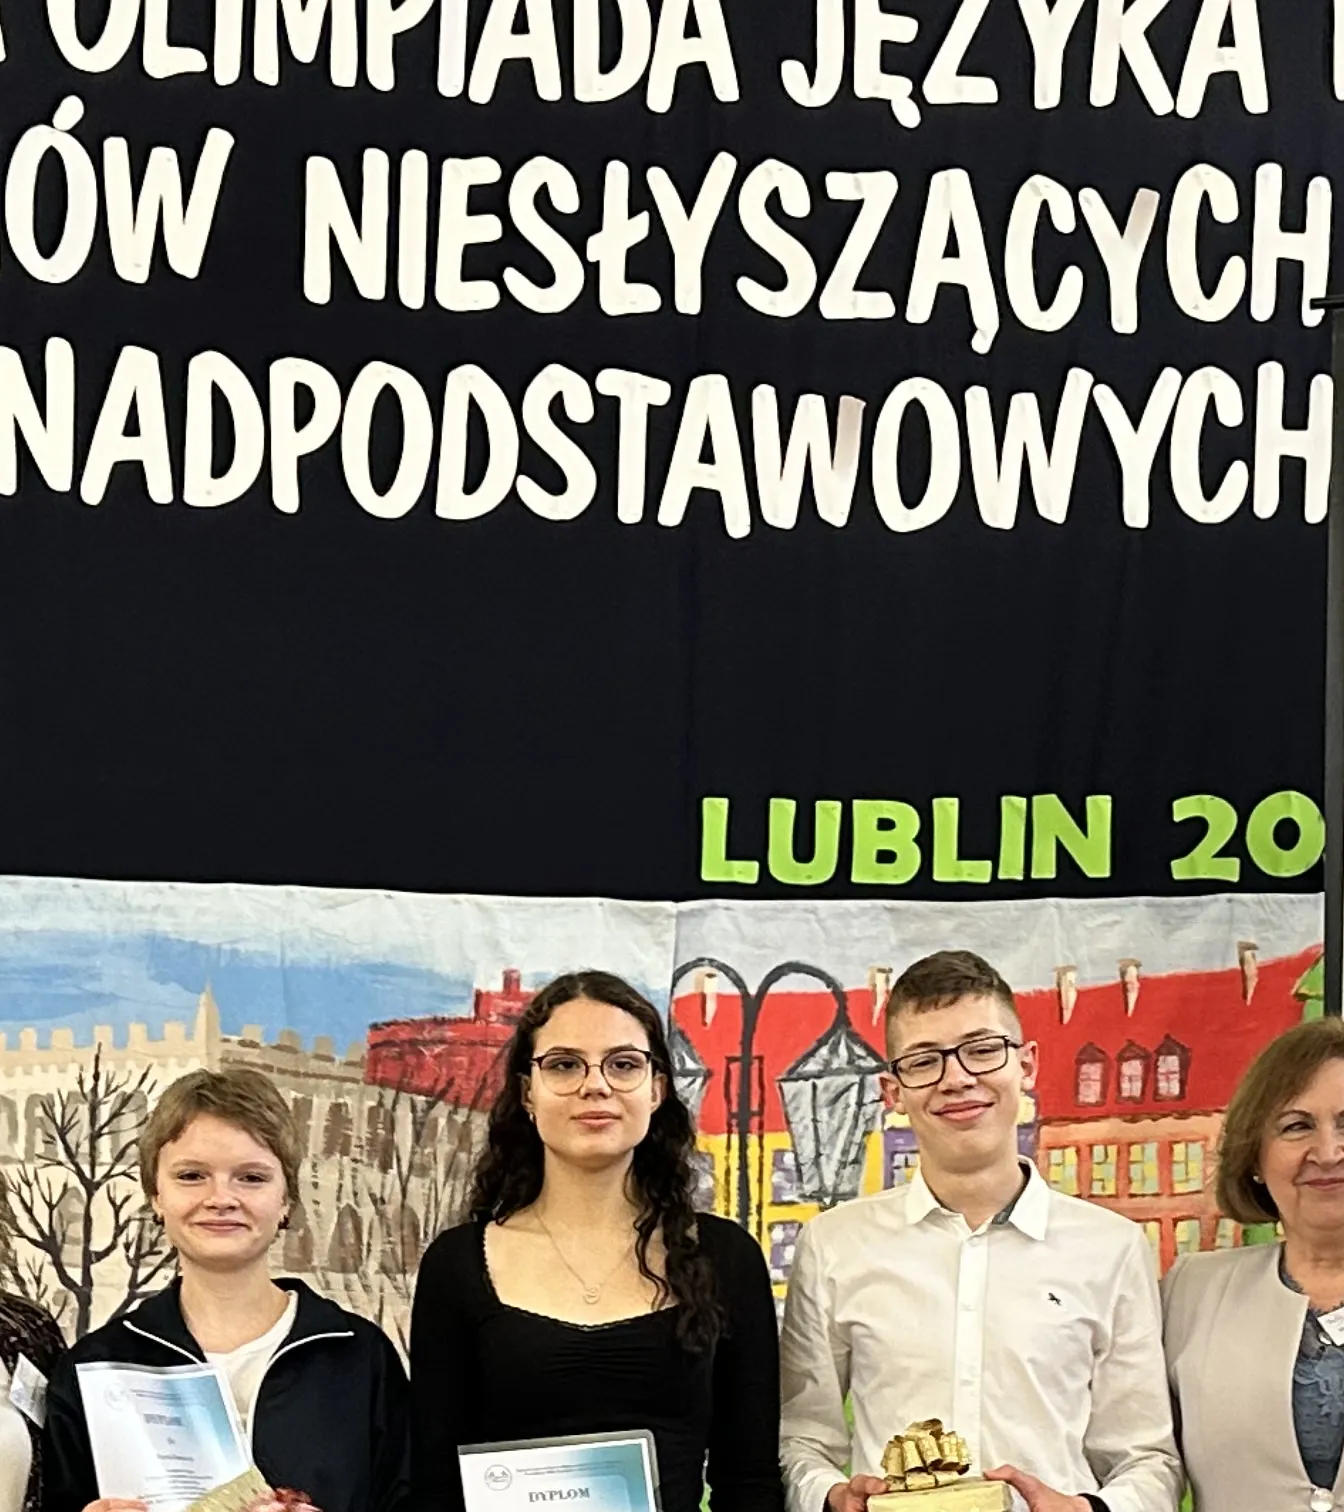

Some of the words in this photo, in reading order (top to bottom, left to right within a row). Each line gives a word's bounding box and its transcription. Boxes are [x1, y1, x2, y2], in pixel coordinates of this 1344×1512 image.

[781, 0, 1268, 128] JĘZYKA
[304, 148, 1332, 354] NIESŁYSZĄCYCH
[701, 794, 1112, 885] LUBLIN
[528, 1488, 590, 1503] DYPLOM
